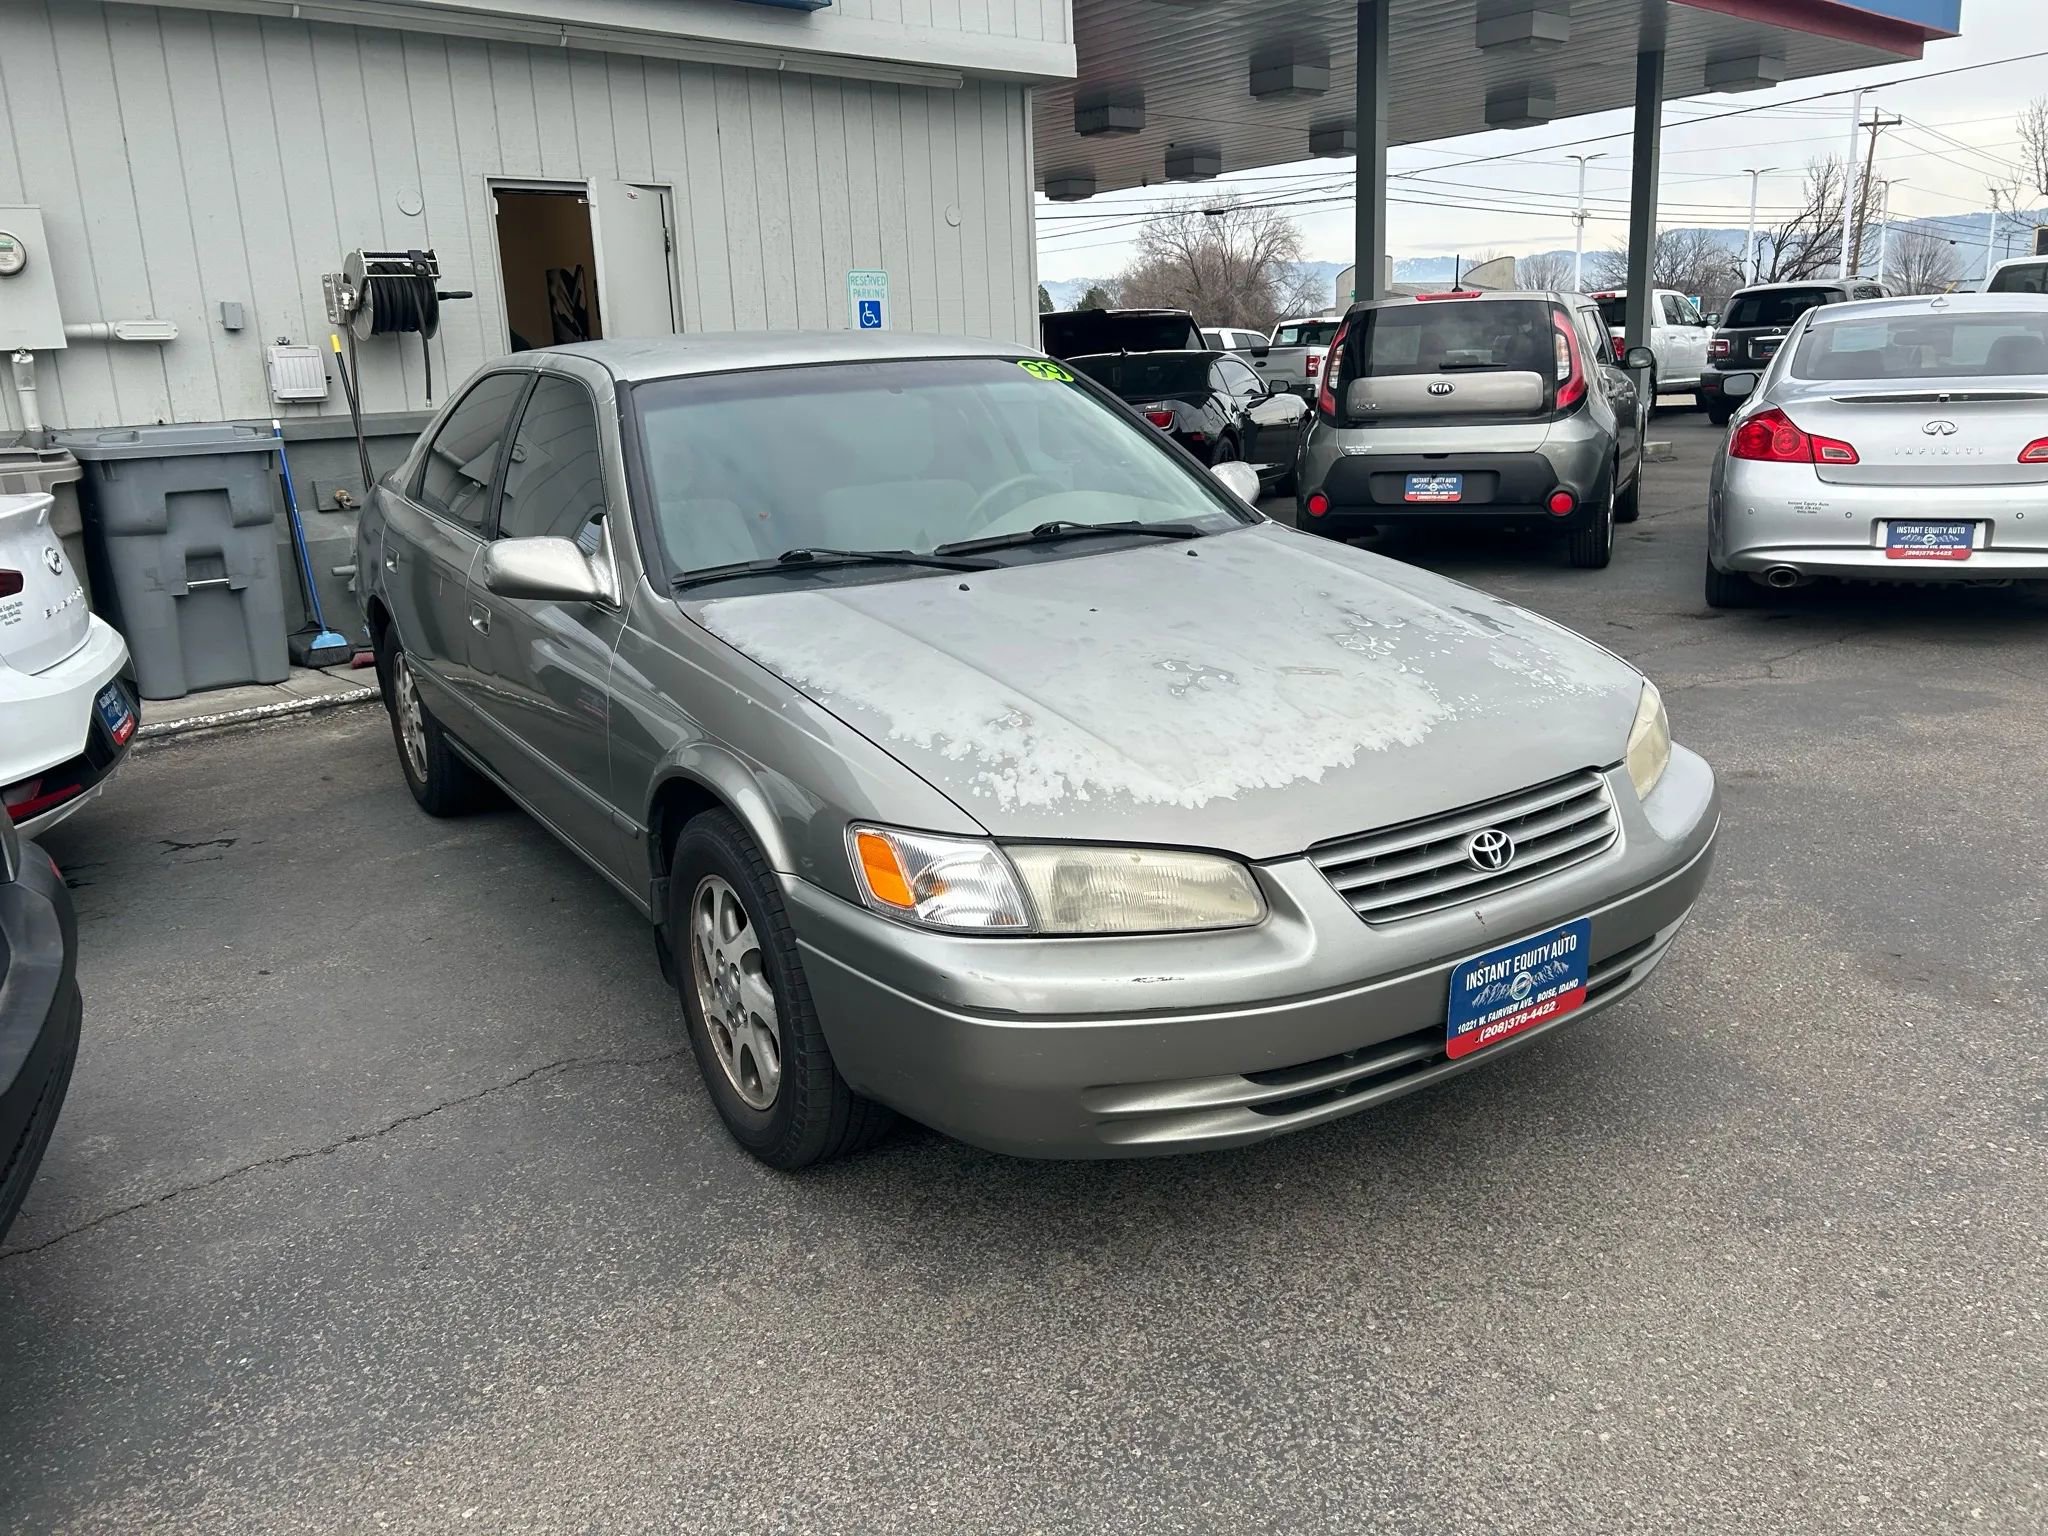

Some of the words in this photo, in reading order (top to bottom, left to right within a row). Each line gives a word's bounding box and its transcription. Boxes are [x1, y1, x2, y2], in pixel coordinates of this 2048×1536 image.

[850, 275, 886, 287] RESERVED
[852, 288, 885, 299] PARKING
[1019, 360, 1071, 381] 99
[1431, 383, 1450, 393] KIA
[1895, 448, 1984, 456] INFINITI
[1896, 526, 1923, 534] INSTANT
[1924, 526, 1947, 534] EQUITY
[1947, 526, 1966, 535] AUTO
[1466, 958, 1512, 991] INSTANT
[1514, 944, 1551, 972] EQUITY
[1551, 934, 1577, 959] AUTO
[1457, 1021, 1477, 1034] 10221
[1478, 1017, 1486, 1026] W.
[1488, 1006, 1519, 1023] FAIRVIEW
[1520, 996, 1534, 1011] AVE.
[1537, 987, 1557, 1003] BOISE,
[1558, 978, 1579, 995] IDAHO
[1479, 1001, 1556, 1042] (208)378-4422
